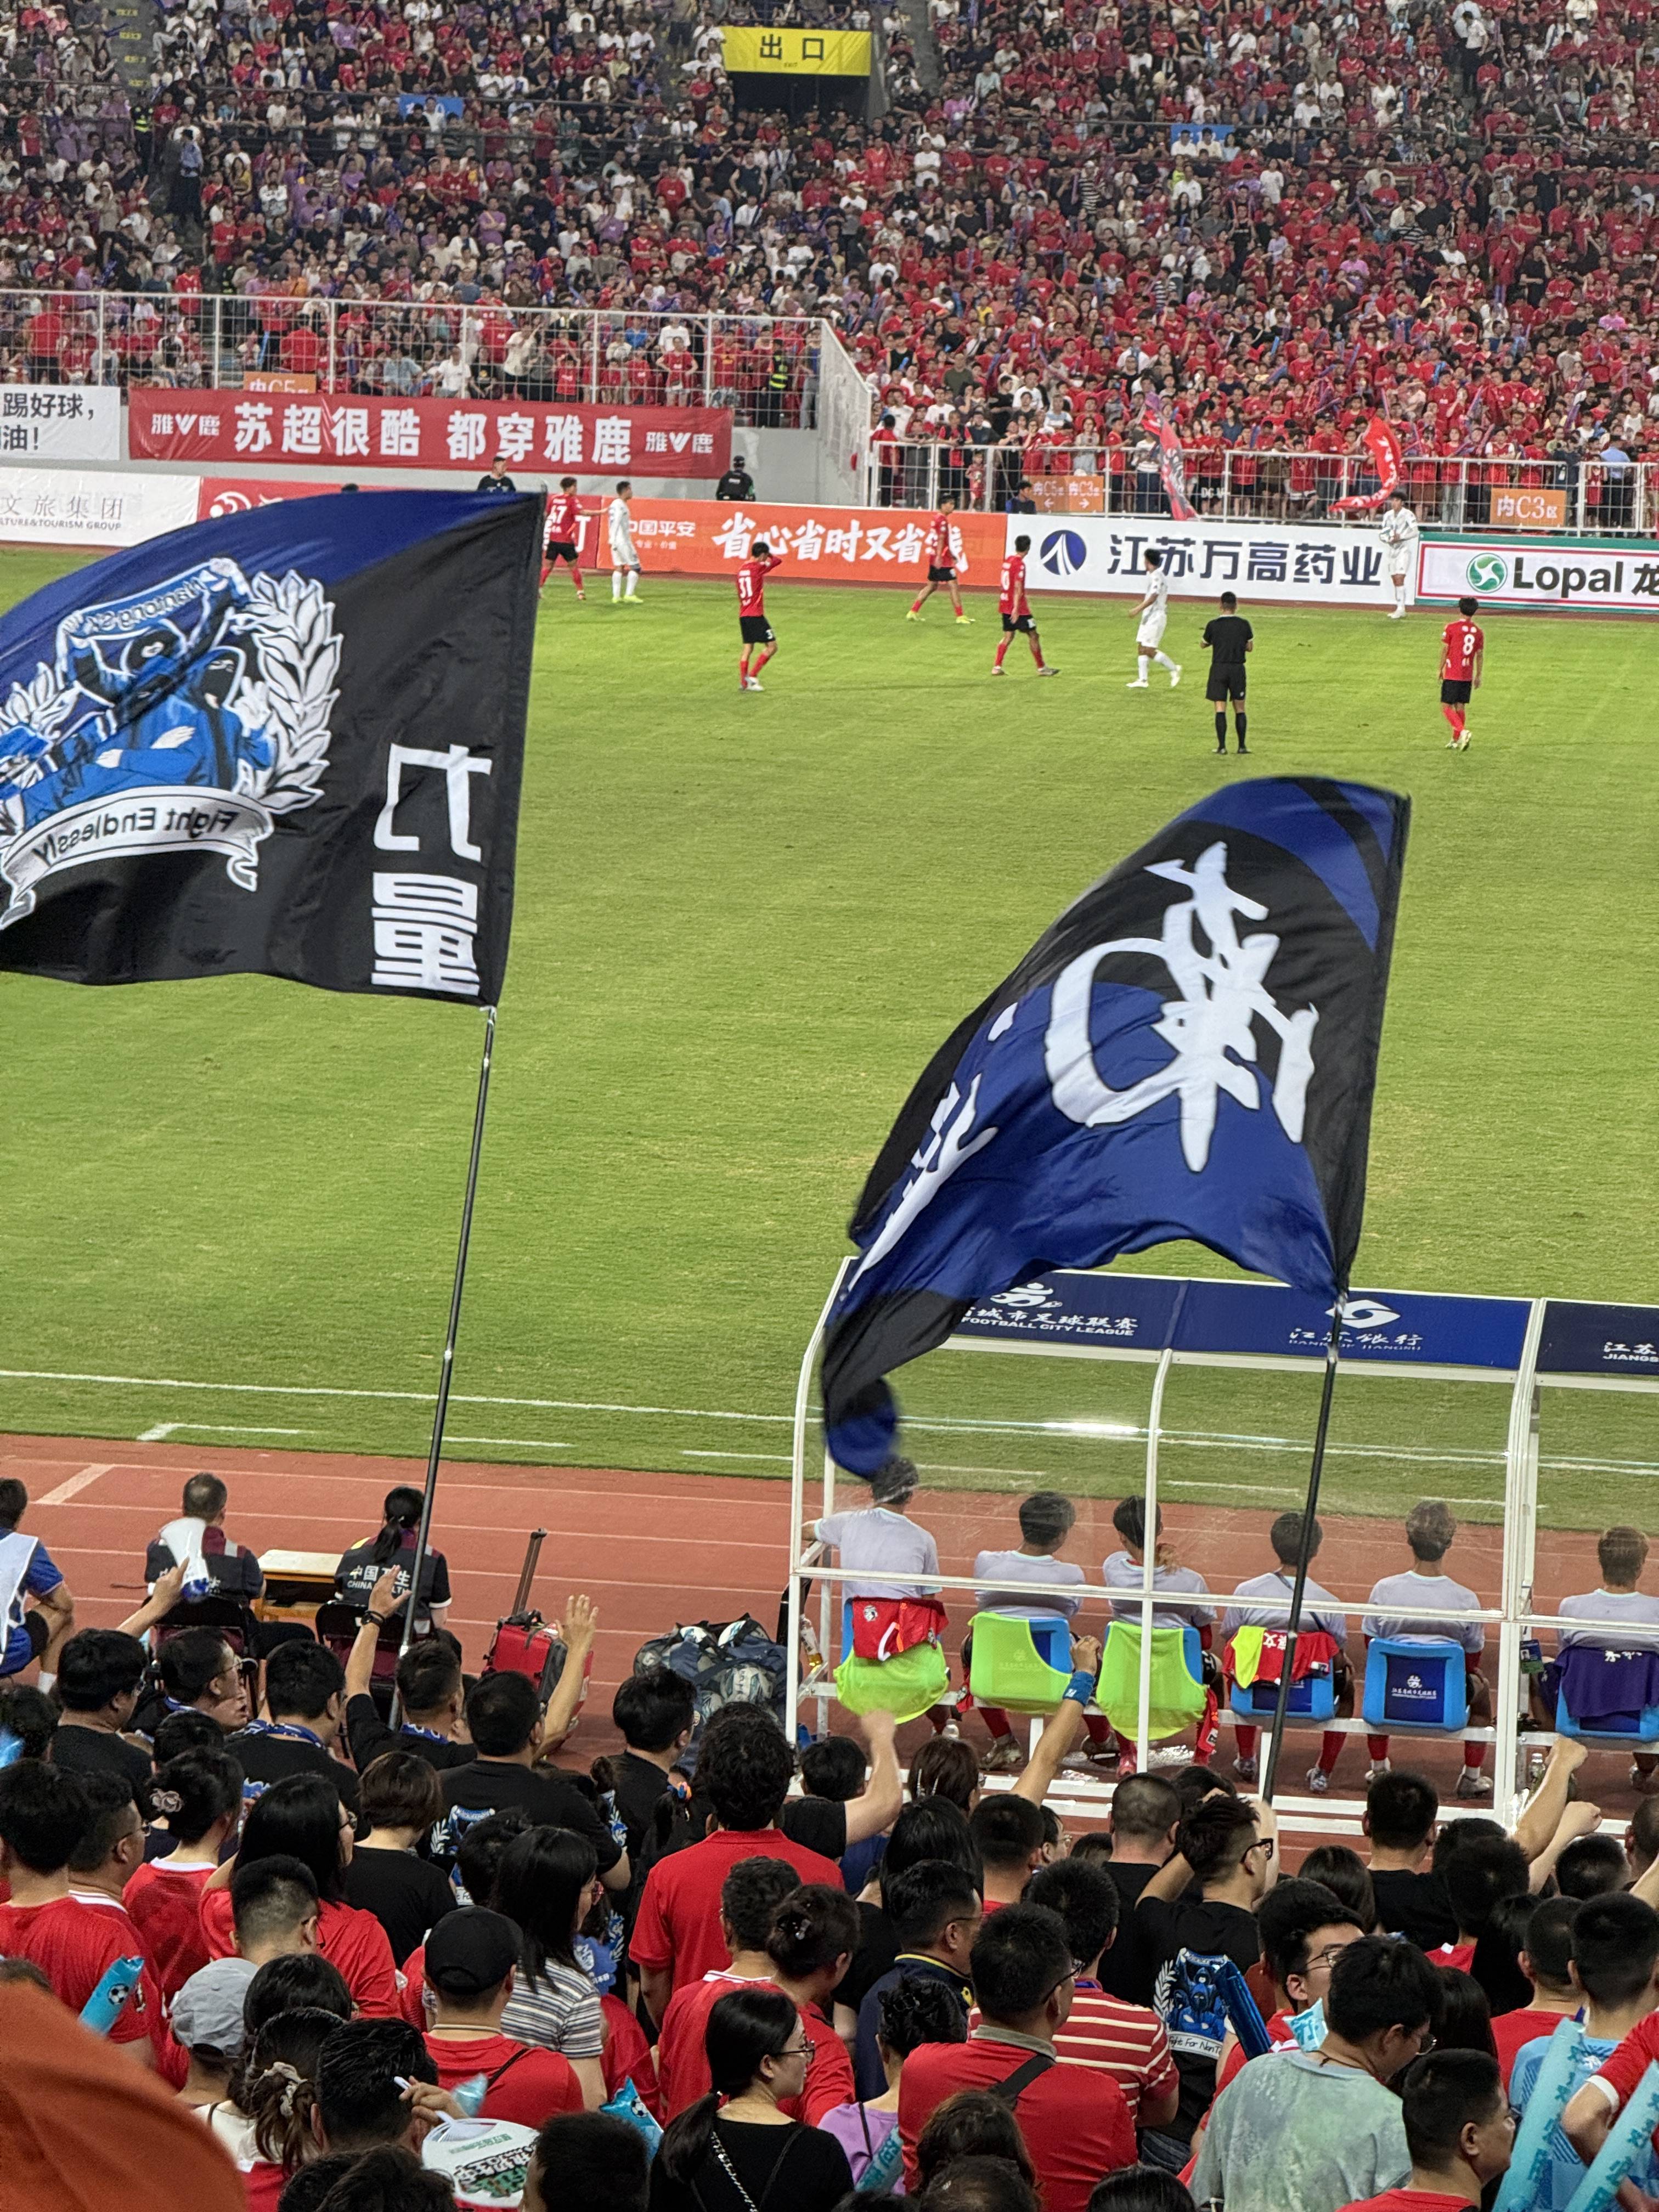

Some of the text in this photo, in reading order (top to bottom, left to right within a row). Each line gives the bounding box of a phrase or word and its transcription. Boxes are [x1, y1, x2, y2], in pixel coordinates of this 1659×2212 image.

[760, 33, 824, 60] 出口
[0, 424, 38, 450] 油！
[234, 402, 421, 456] 苏超很酷
[447, 410, 632, 465] 都穿雅鹿
[0, 494, 123, 520] 文旅集团
[1497, 495, 1558, 518] 内C3区
[1107, 534, 1383, 586] 江苏万高药业
[1513, 557, 1624, 599] Lopal
[1463, 634, 1475, 656] 8
[961, 1316, 1136, 1336] FOOTBALL CITY LEAGUE
[347, 1580, 373, 1590] CHINA
